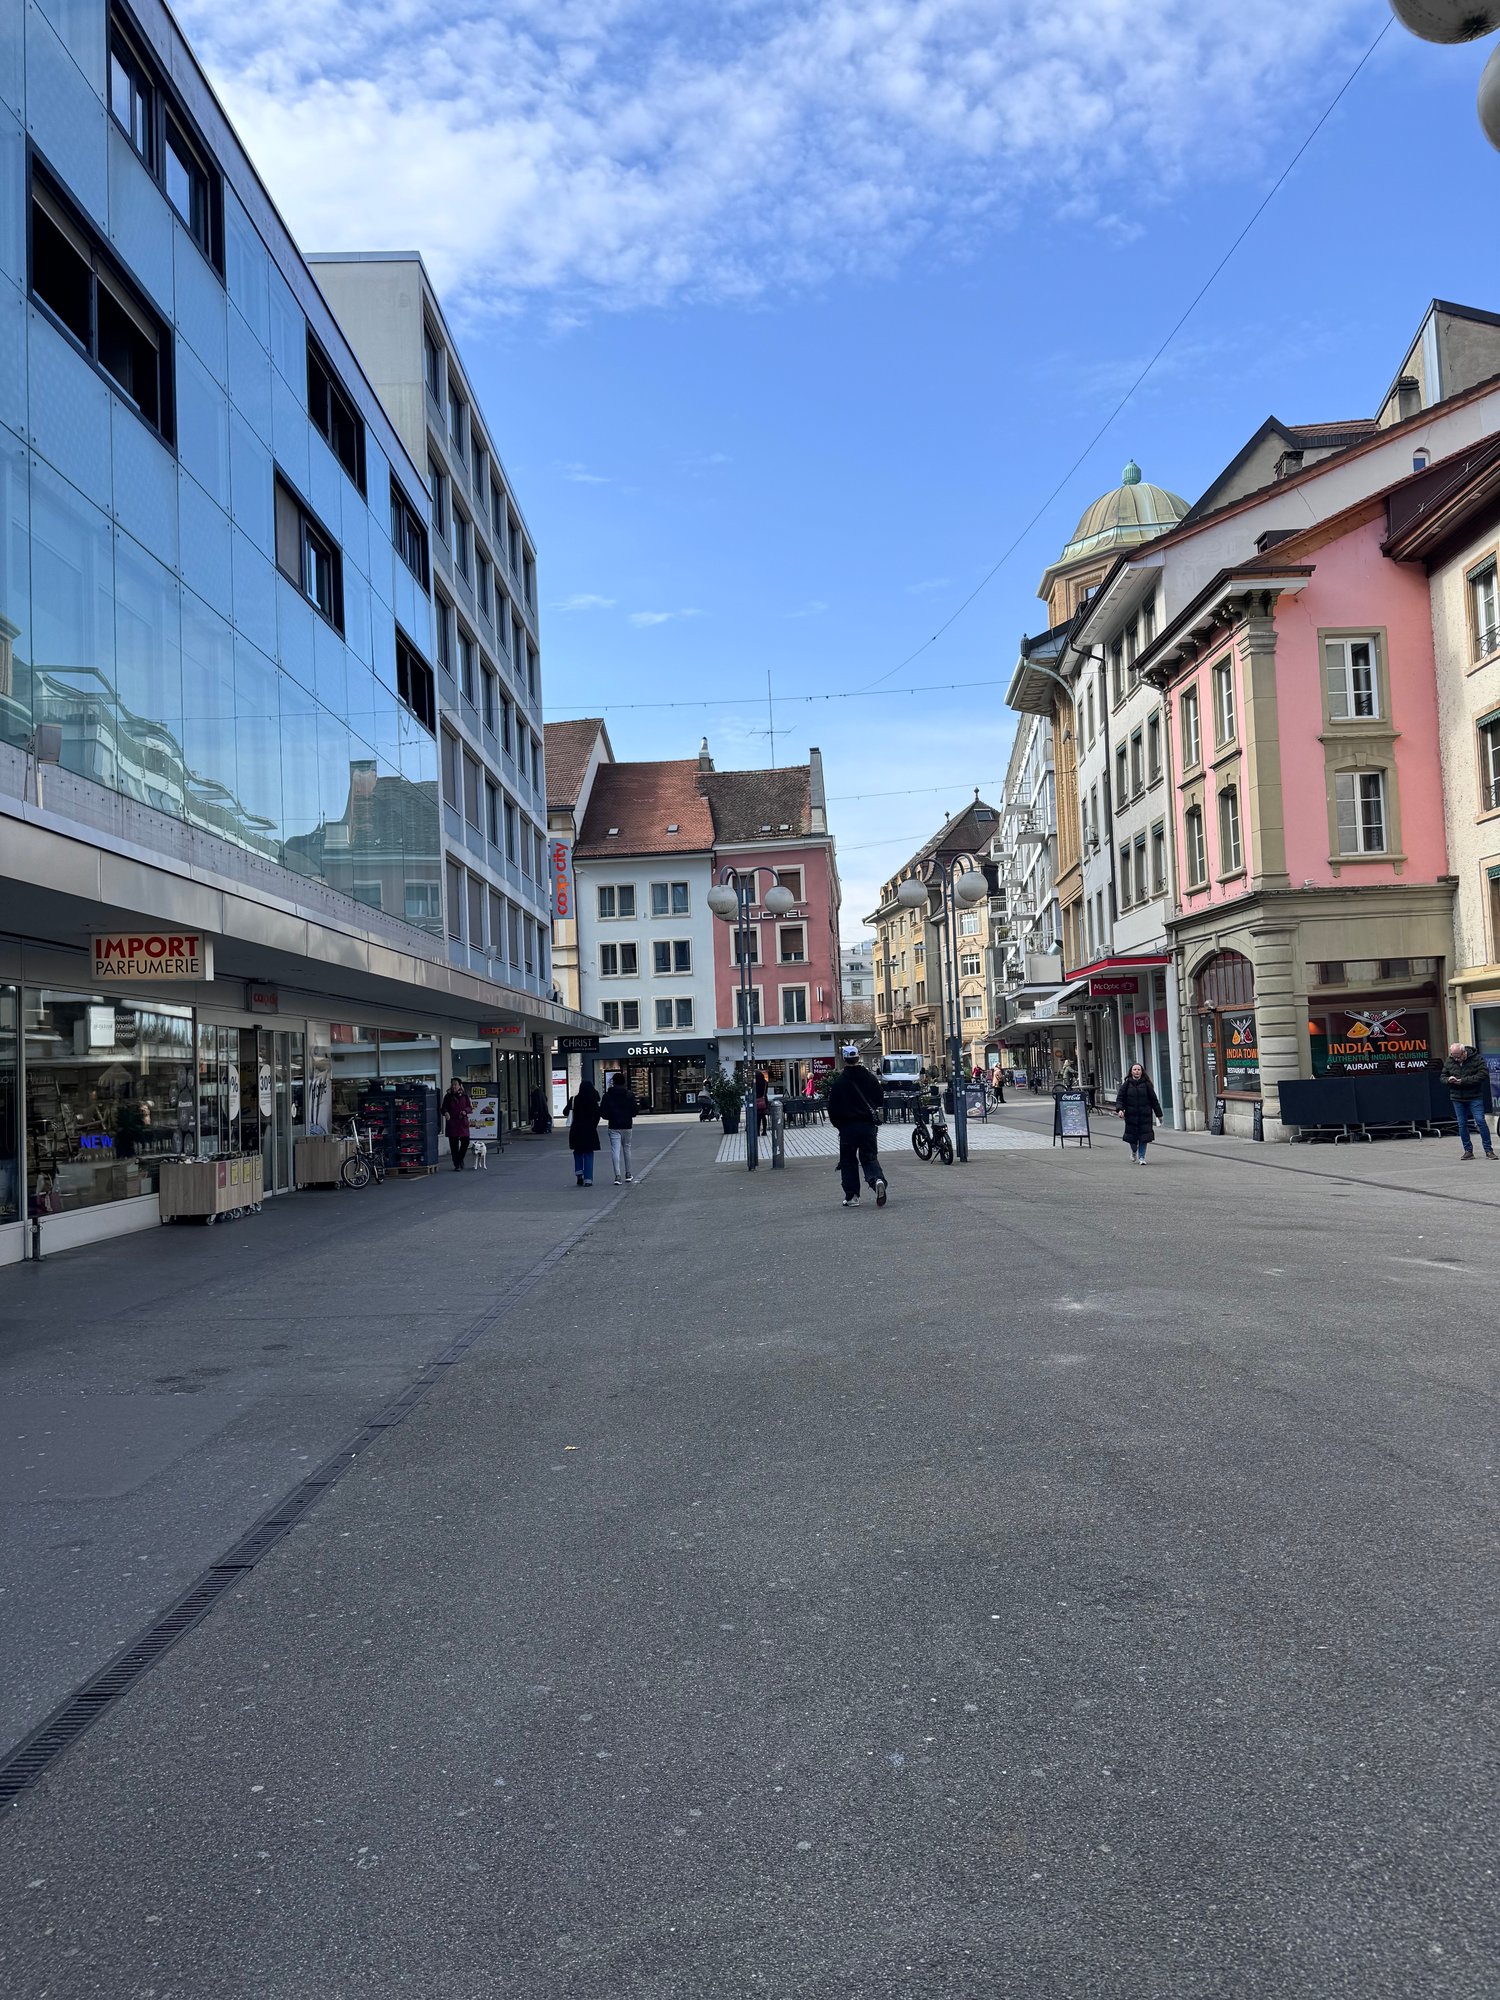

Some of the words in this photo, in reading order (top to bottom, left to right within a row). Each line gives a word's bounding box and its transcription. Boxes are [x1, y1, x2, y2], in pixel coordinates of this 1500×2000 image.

[552, 842, 569, 872] city
[557, 873, 570, 915] coop
[95, 936, 199, 960] IMPORT
[95, 958, 199, 976] PARFUMERIE
[562, 1038, 592, 1048] CHRIST
[1328, 1043, 1375, 1055] INDIA
[1377, 1039, 1427, 1052] TOWN
[627, 1046, 670, 1056] ORSENA
[1226, 1048, 1243, 1059] INDIA
[1243, 1048, 1259, 1059] TOW
[1327, 1054, 1370, 1063] AUTHENTIC
[1371, 1053, 1397, 1061] INDIAN
[1398, 1051, 1429, 1059] CUISINE
[472, 1087, 486, 1095] Hits
[81, 1134, 113, 1149] NEW
